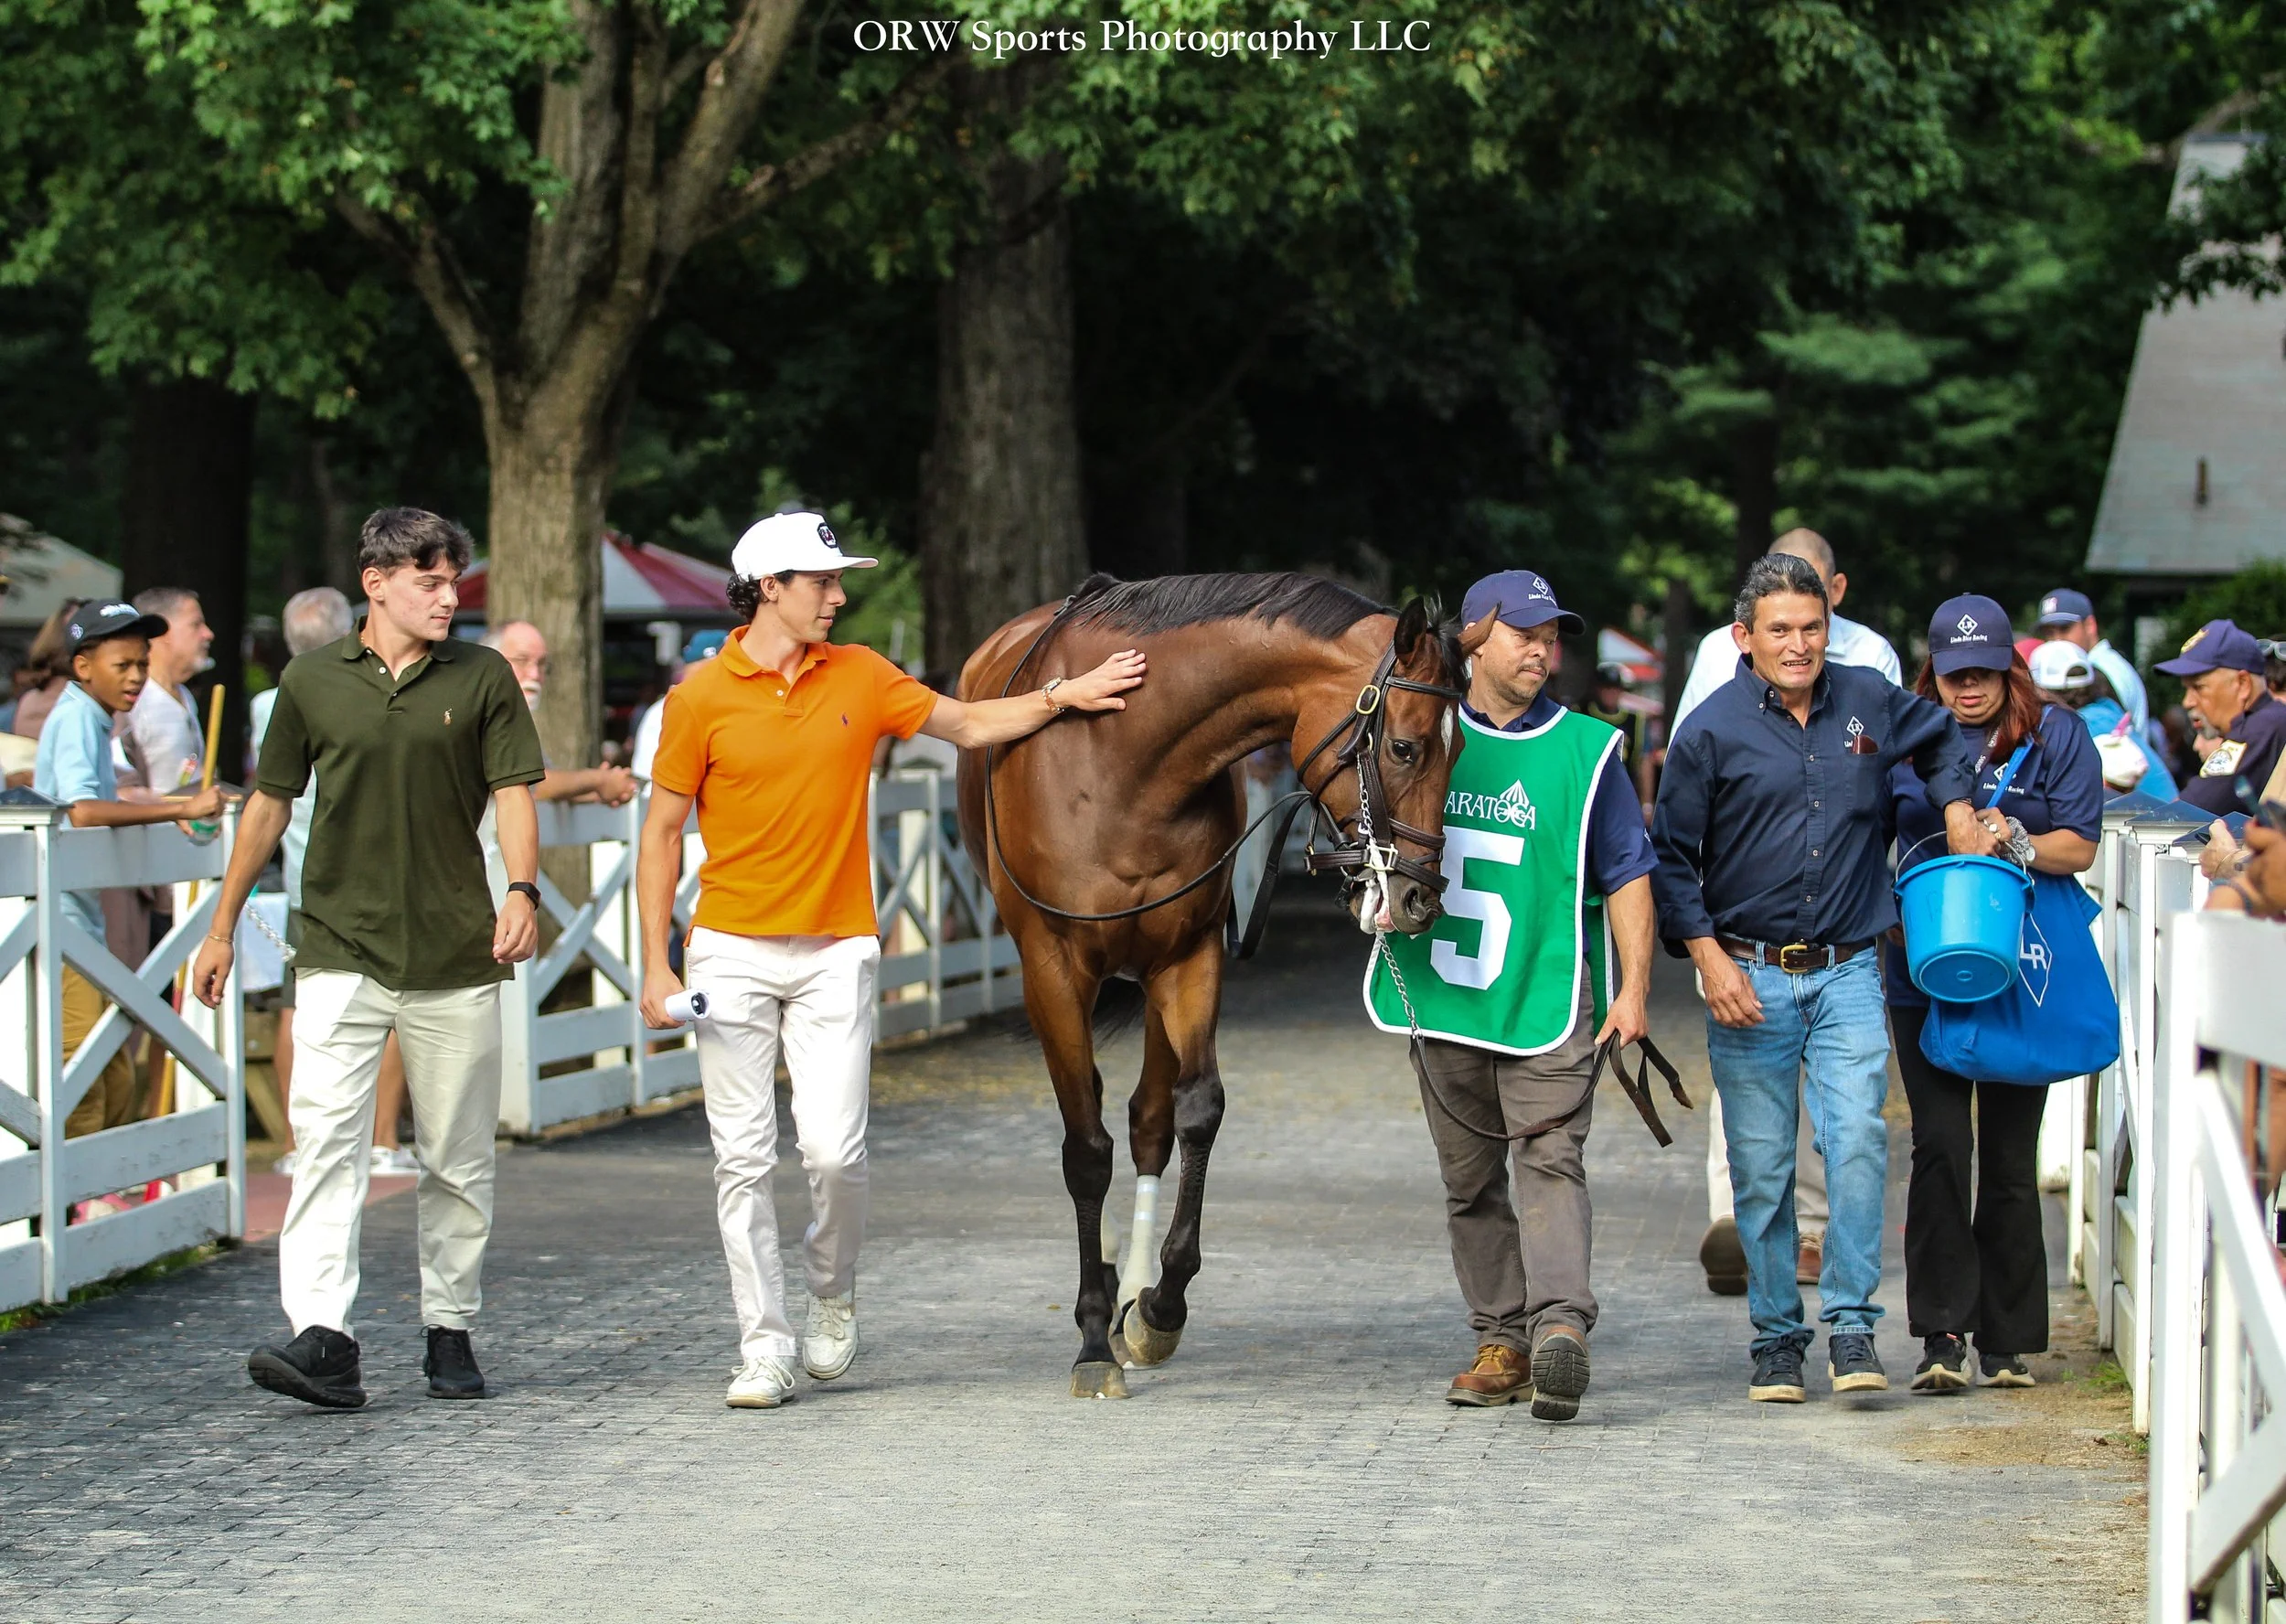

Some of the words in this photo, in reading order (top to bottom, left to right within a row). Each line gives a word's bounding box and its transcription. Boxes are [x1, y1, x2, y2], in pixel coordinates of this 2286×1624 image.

[1444, 790, 1536, 830] ARATOGA
[1429, 825, 1525, 990] 5
[2019, 933, 2047, 969] LR
